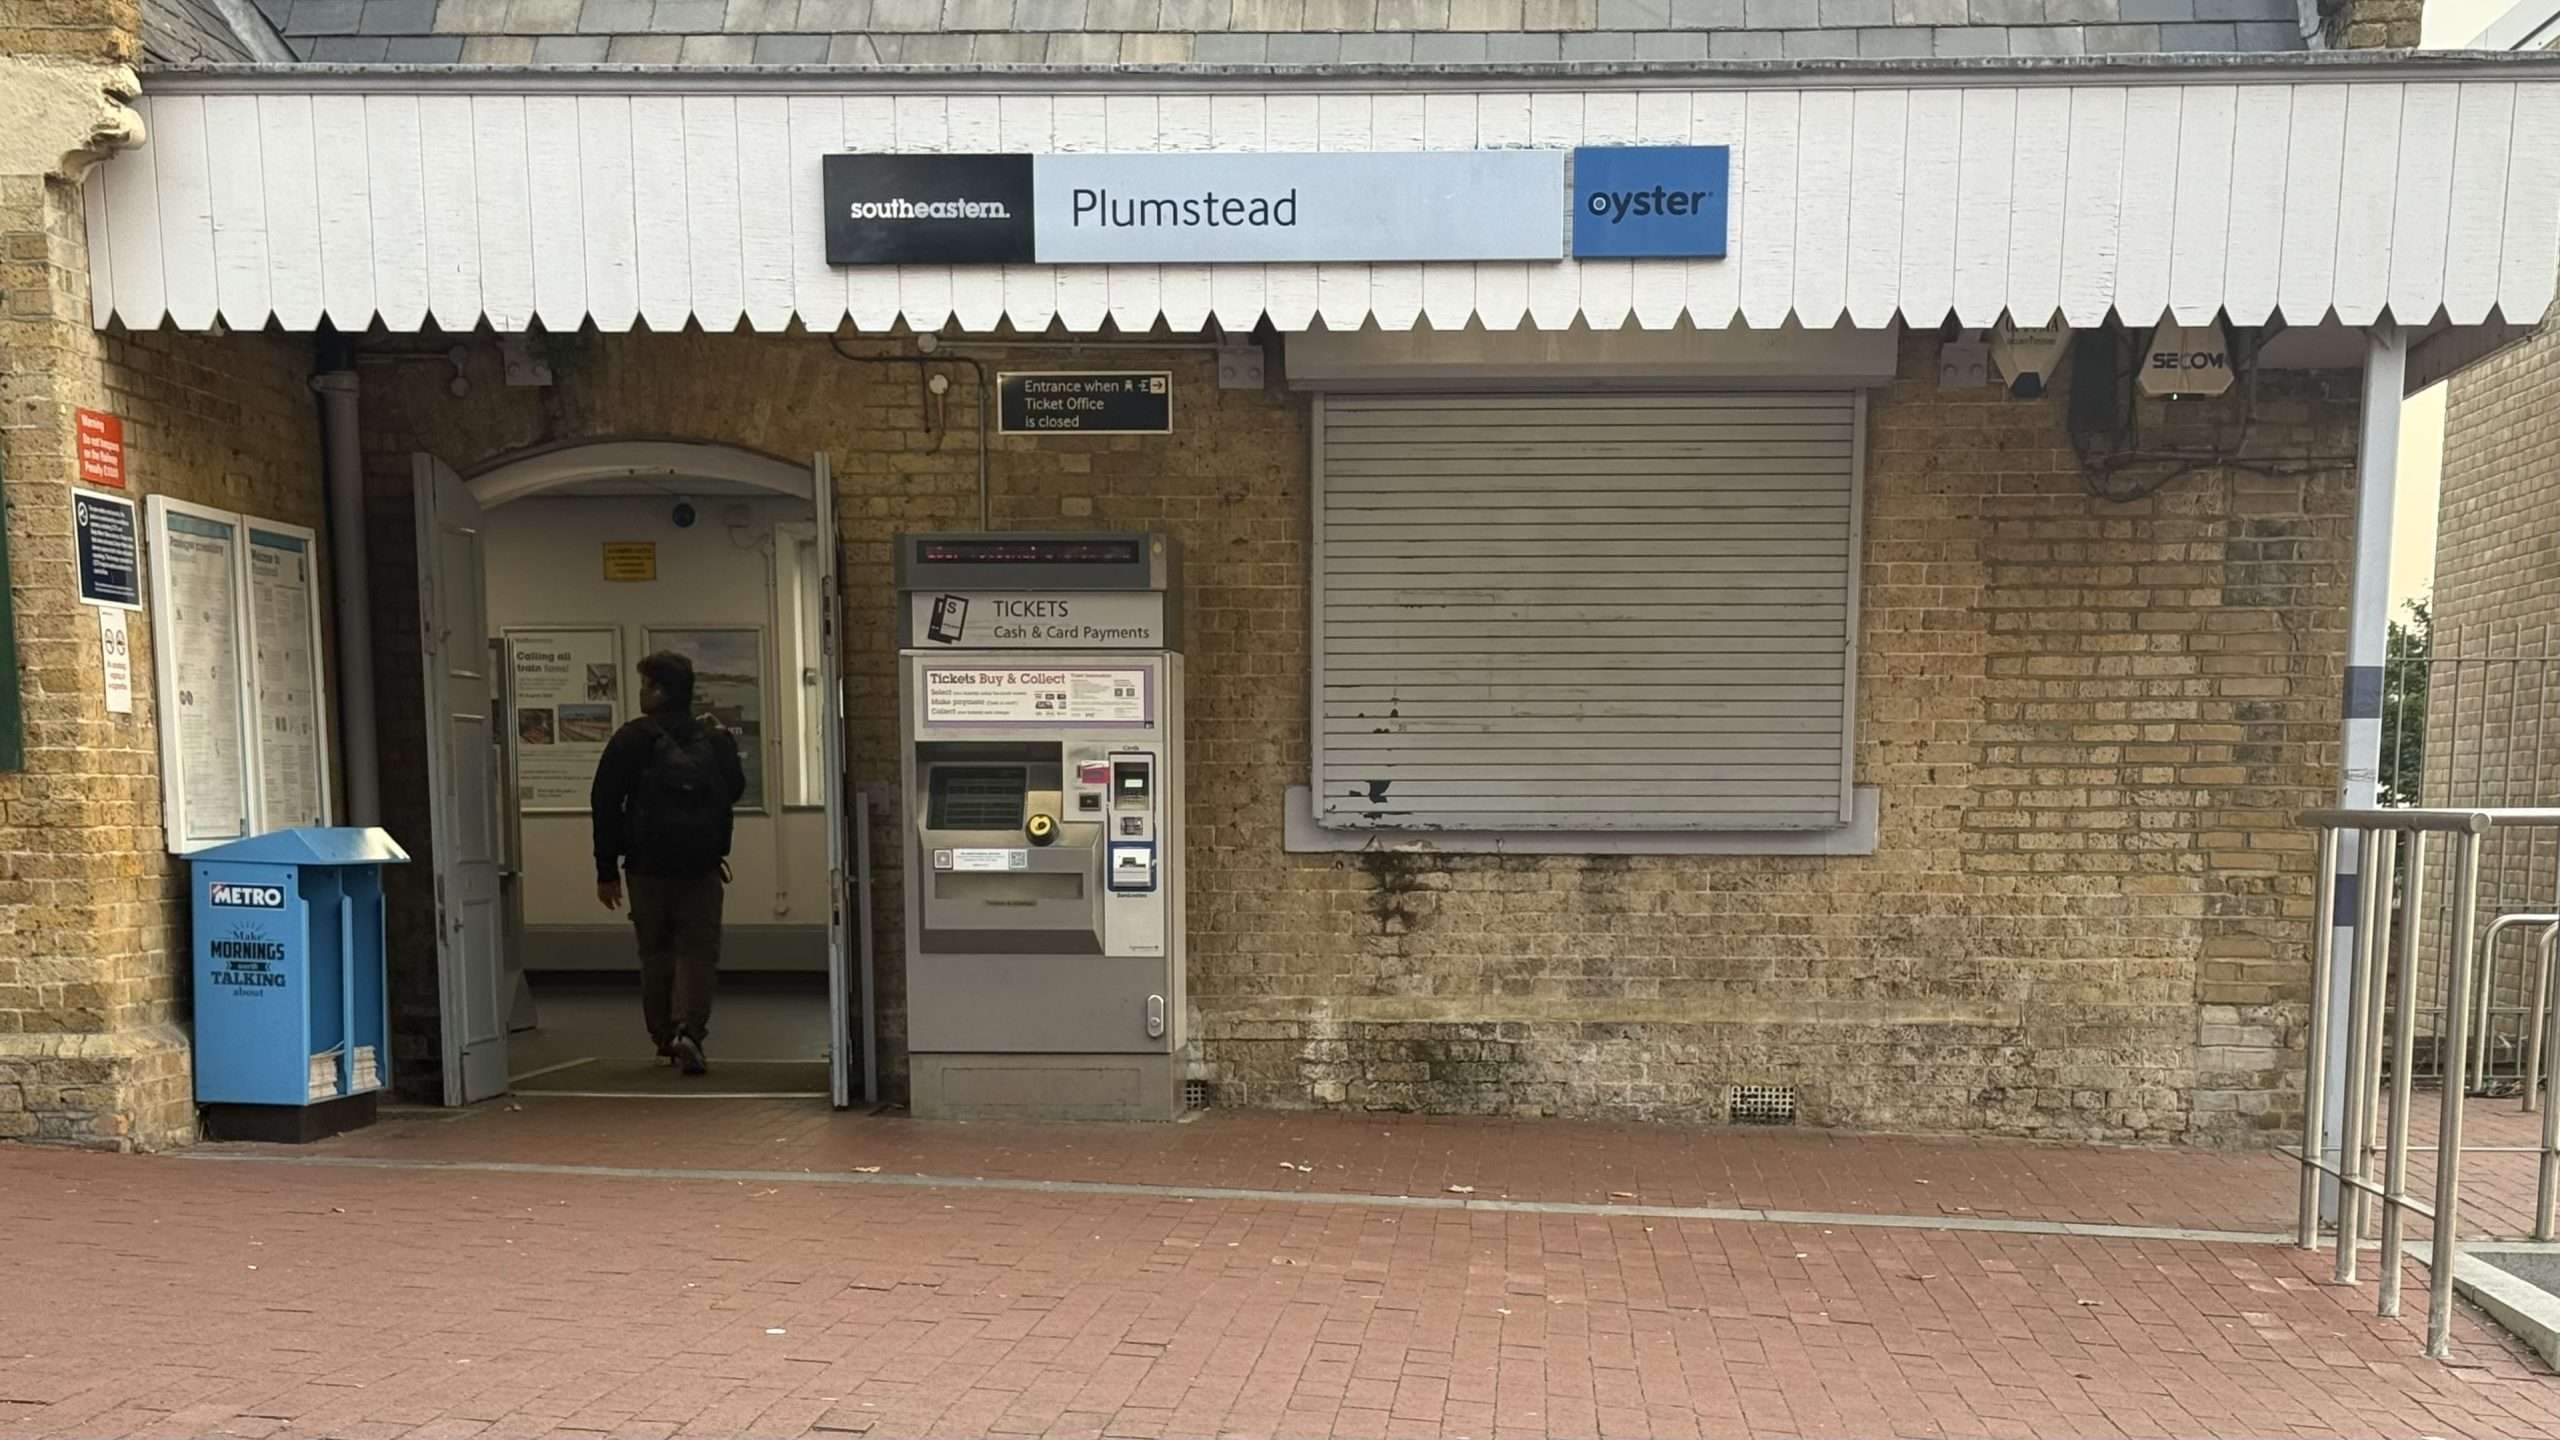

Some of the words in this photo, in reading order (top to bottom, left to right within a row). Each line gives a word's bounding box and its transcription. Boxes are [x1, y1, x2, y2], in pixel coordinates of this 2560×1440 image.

[1073, 188, 1297, 227] Plumstead
[1588, 186, 1705, 224] oyster
[2152, 352, 2225, 369] SECOM
[1024, 379, 1081, 393] Entrance
[1084, 379, 1120, 393] when
[1025, 398, 1063, 411] Ticket
[1066, 397, 1105, 411] Office
[1025, 415, 1036, 428] is
[1038, 415, 1080, 428] closed
[992, 600, 1069, 617] TICKETS
[994, 625, 1027, 639] Cash
[1031, 626, 1042, 639] &
[1047, 625, 1079, 639] Card
[1084, 625, 1150, 642] Payments
[516, 651, 555, 663] Calling
[557, 651, 571, 662] all
[517, 663, 542, 673] train
[930, 673, 976, 685] Tickets
[979, 673, 1003, 687] Buy
[1007, 673, 1018, 685] &
[1020, 673, 1066, 685] Collect
[213, 885, 282, 906] METRO
[210, 940, 286, 961] MORNINGS
[210, 971, 287, 988] TALKING
